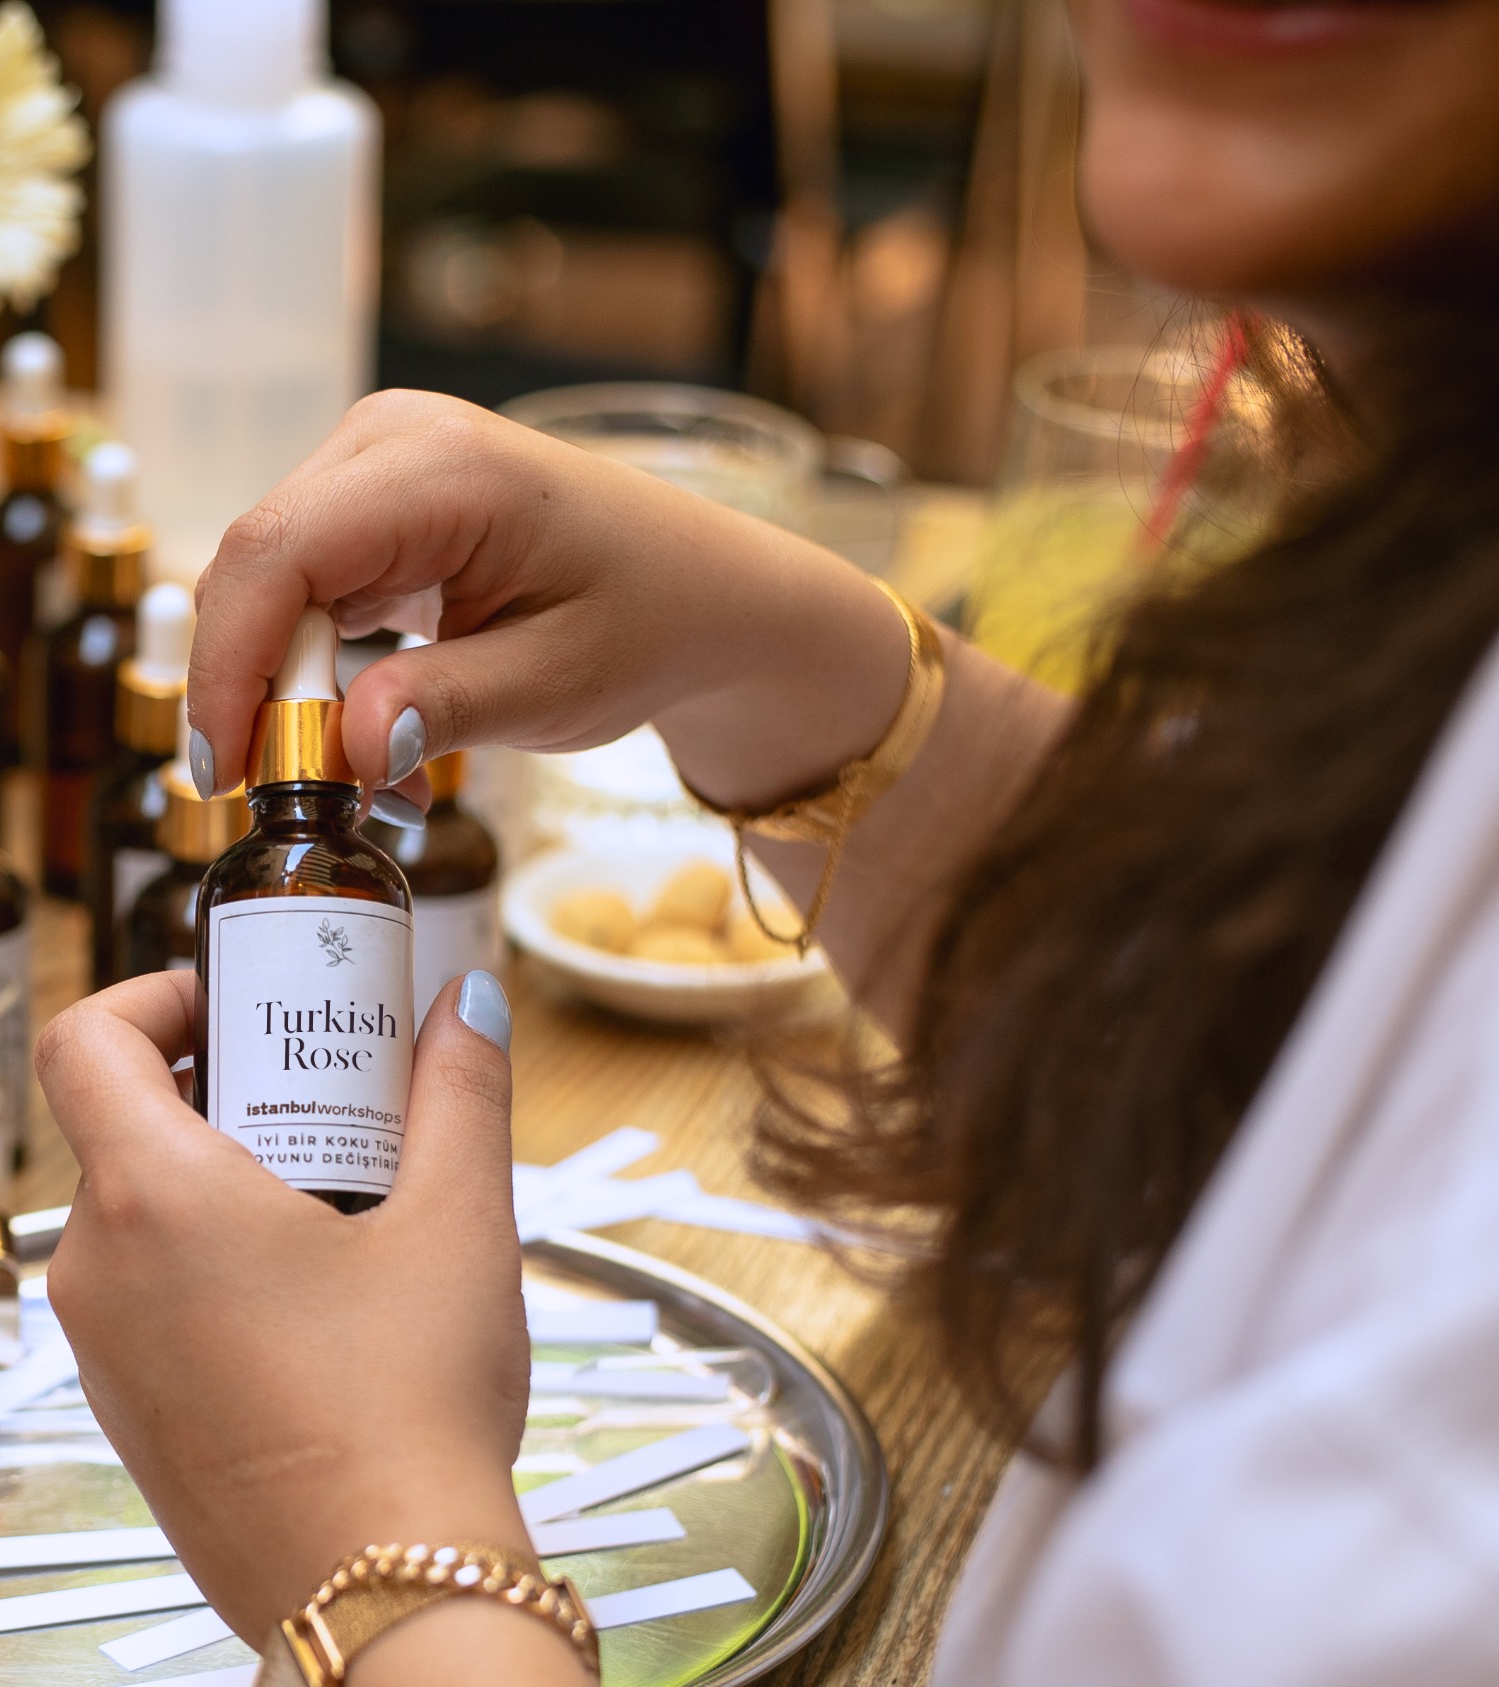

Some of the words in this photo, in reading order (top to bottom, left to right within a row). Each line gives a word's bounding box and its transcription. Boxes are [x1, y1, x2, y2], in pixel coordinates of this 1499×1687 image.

[256, 1000, 397, 1037] Turkish
[282, 1037, 373, 1072] Rose
[246, 1100, 402, 1124] istanbulworkshops
[288, 1132, 317, 1146] BİR
[325, 1135, 369, 1149] KOKU
[375, 1139, 398, 1154] TÜM
